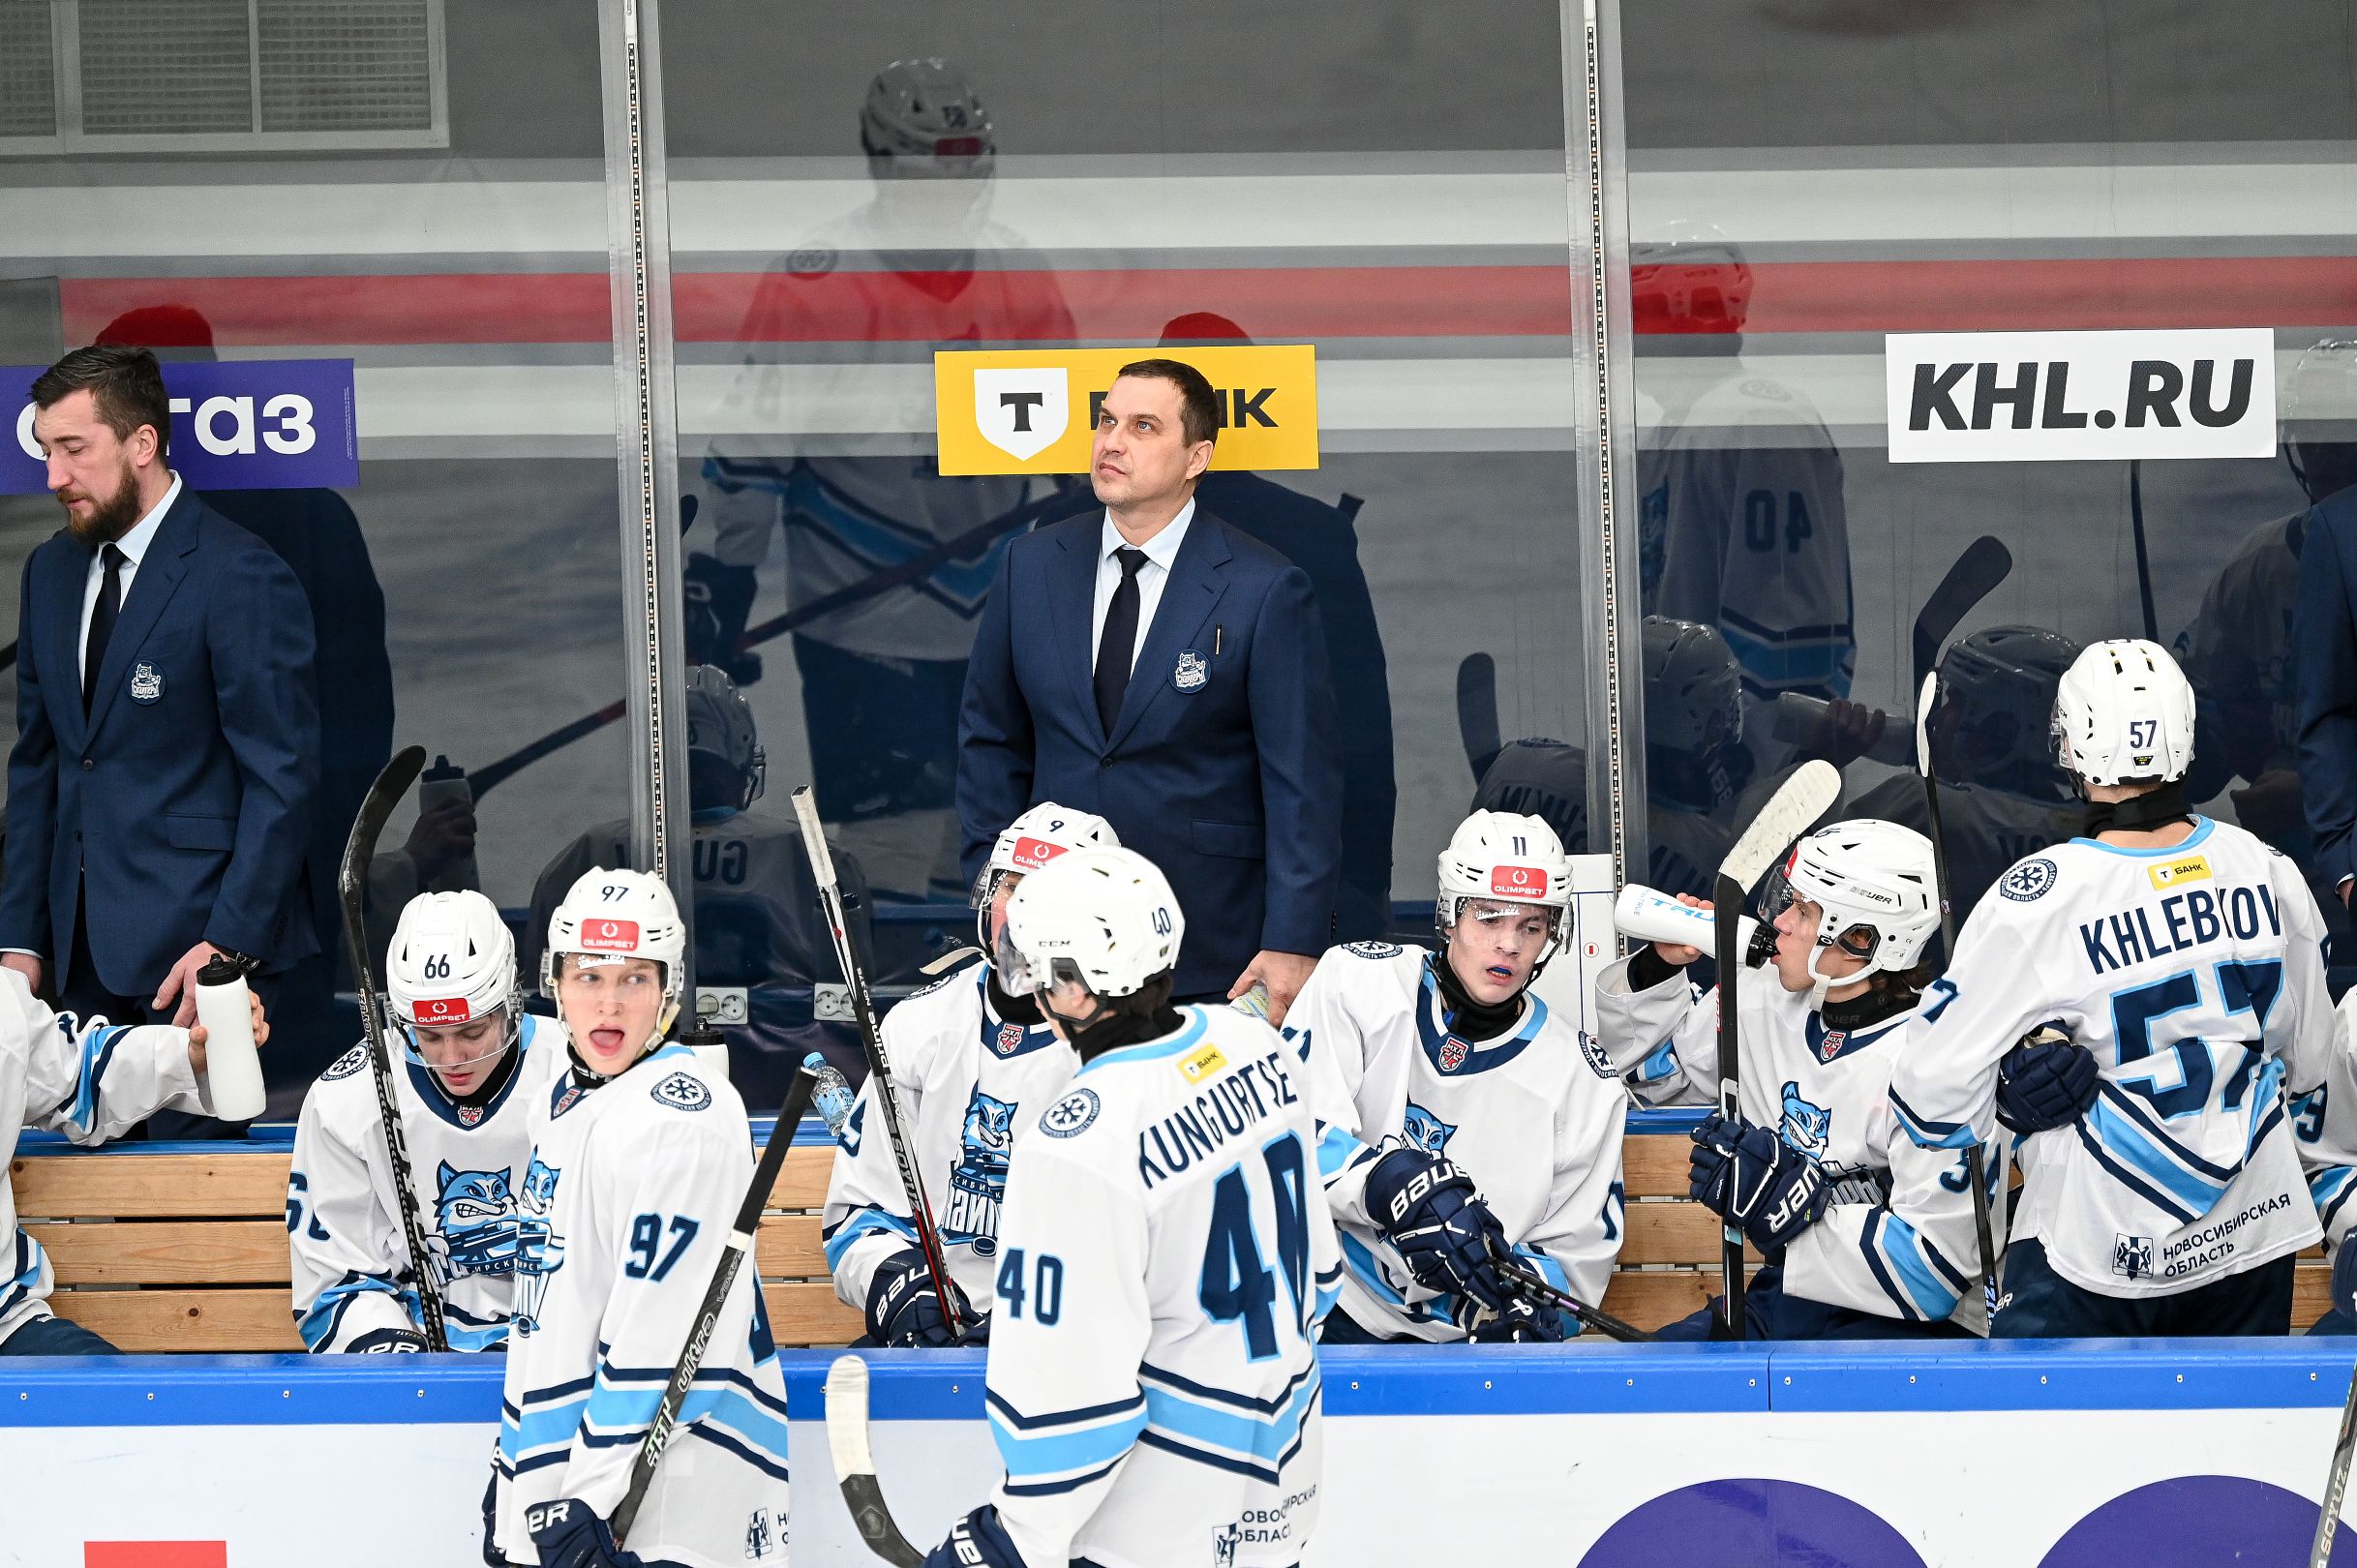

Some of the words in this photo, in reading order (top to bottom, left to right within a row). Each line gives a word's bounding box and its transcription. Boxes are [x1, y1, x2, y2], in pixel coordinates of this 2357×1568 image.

[1909, 359, 2254, 431] KHL.RU
[2130, 720, 2157, 748] 57
[1049, 820, 1065, 832] 9
[1512, 836, 1526, 856] 11
[2174, 862, 2204, 875] БАНК
[602, 886, 630, 902] 97
[1495, 886, 1543, 896] OLIMPBET
[1151, 907, 1171, 936] 40
[583, 938, 634, 949] OLIMPBET
[424, 954, 450, 980] 66
[418, 1013, 467, 1024] OLIMPBET
[867, 1011, 890, 1070] prime
[2109, 956, 2284, 1123] 57
[891, 1137, 921, 1212] SOYUZ
[2163, 1193, 2291, 1260] НОВОСИБИРСКАЯ
[624, 1213, 700, 1283] 97
[1197, 1129, 1316, 1364] 40
[2164, 1242, 2235, 1278] ОБЛАСТЬ
[995, 1246, 1066, 1328] 40
[2320, 1465, 2347, 1555] SOYUZ
